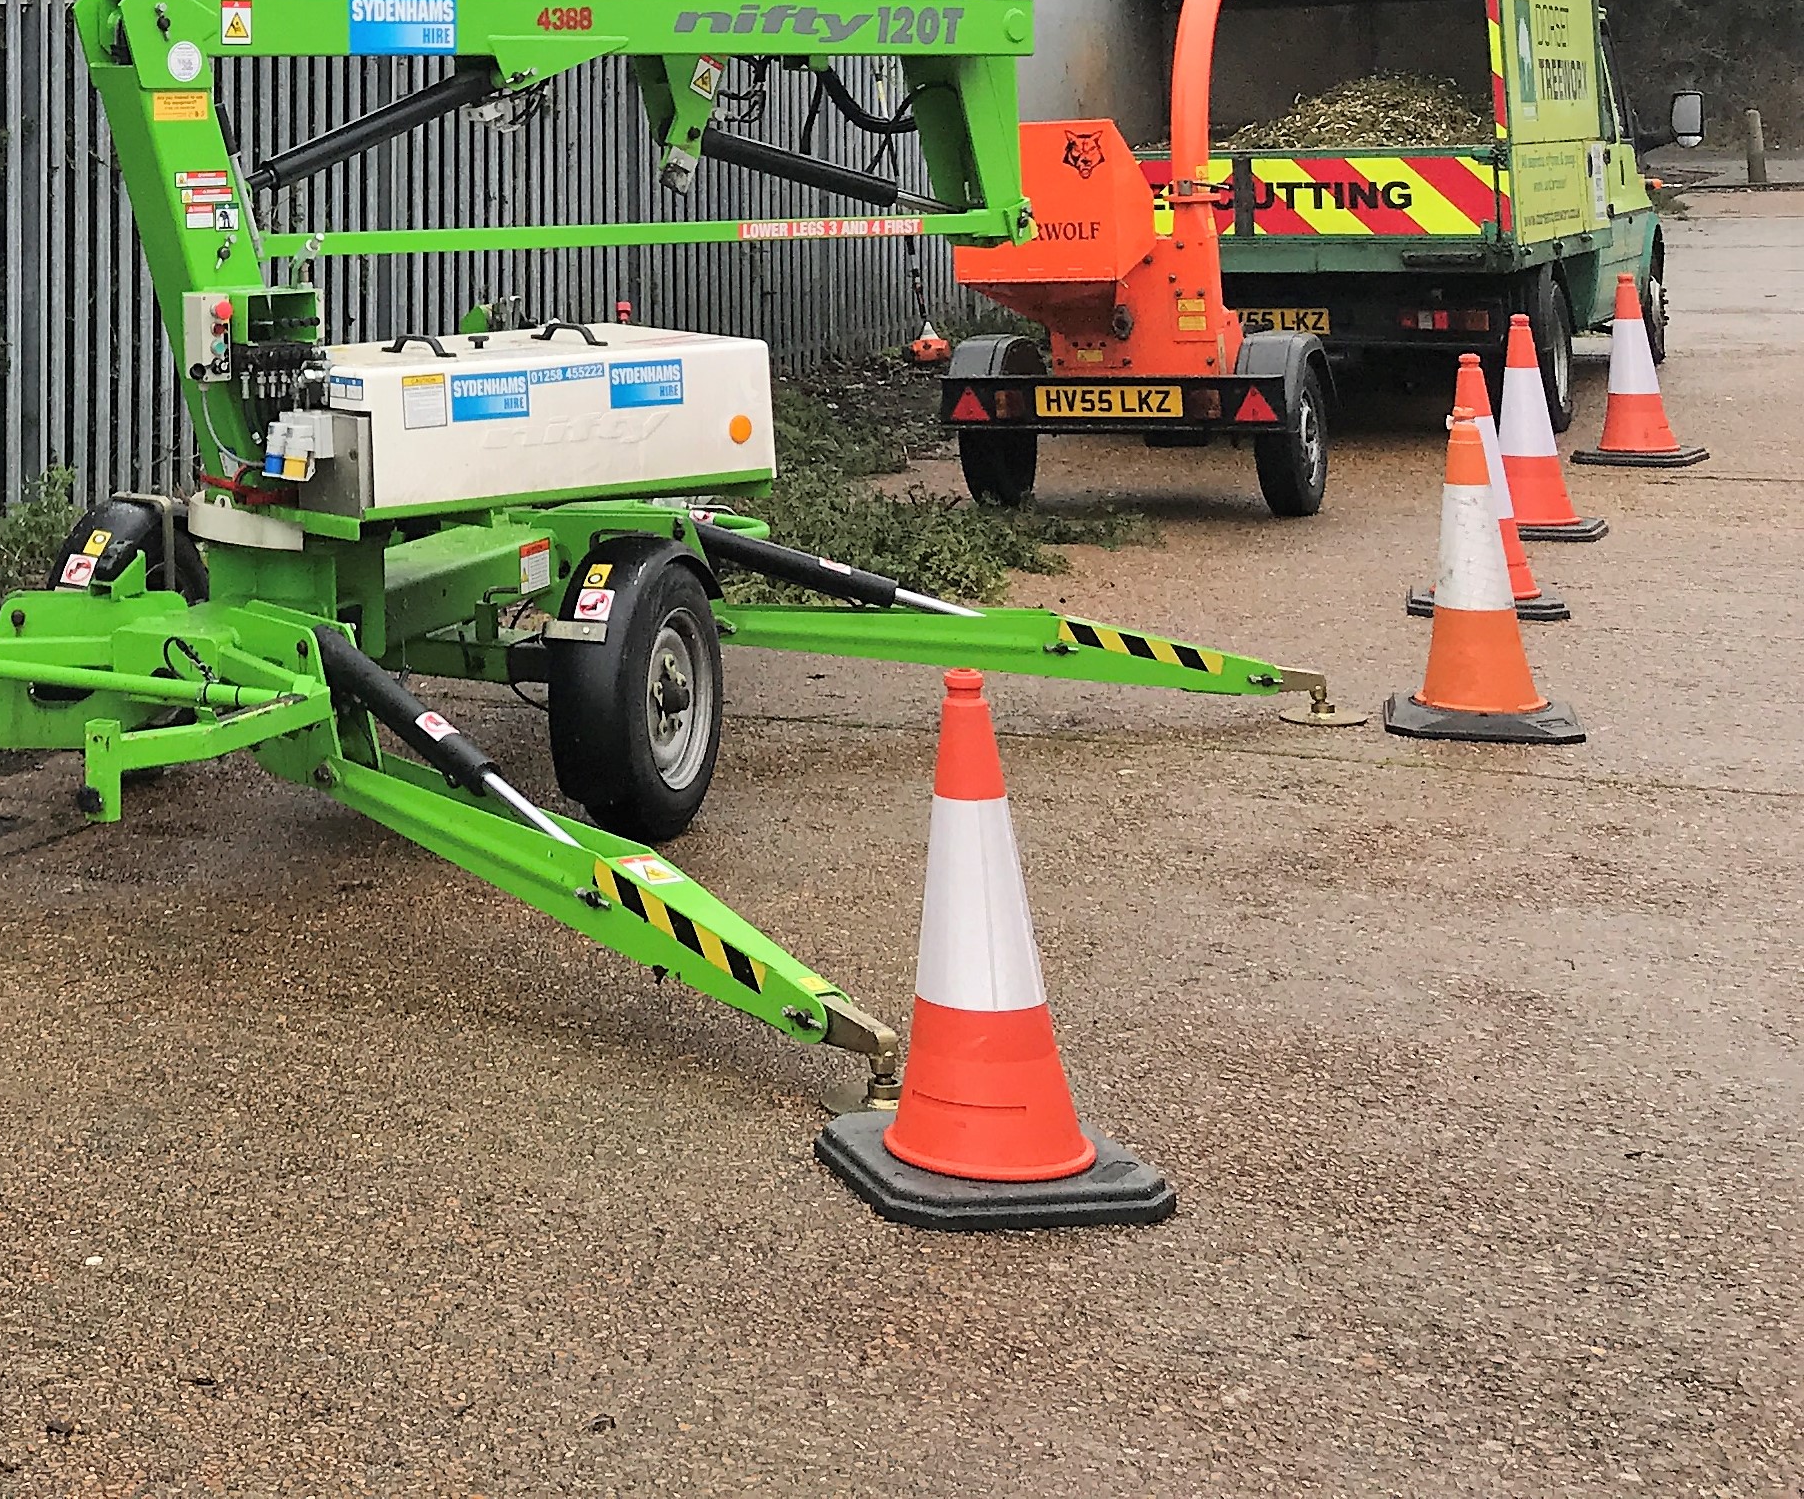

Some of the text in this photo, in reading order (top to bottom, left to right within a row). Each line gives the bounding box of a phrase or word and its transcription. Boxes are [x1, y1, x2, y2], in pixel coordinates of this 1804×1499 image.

[674, 4, 965, 45] nifty 120T
[422, 27, 451, 44] HIRE
[742, 218, 921, 239] LOWER LEGS 3 AND 4 FIRST
[1280, 311, 1326, 331] LKZ
[530, 364, 604, 383] 01258 455222
[611, 364, 681, 385] SYDENHAMS
[453, 376, 527, 398] SYDENHAMS
[658, 383, 680, 398] HIRE
[503, 396, 524, 410] HIRE
[1046, 389, 1172, 413] HV55 LKZ
